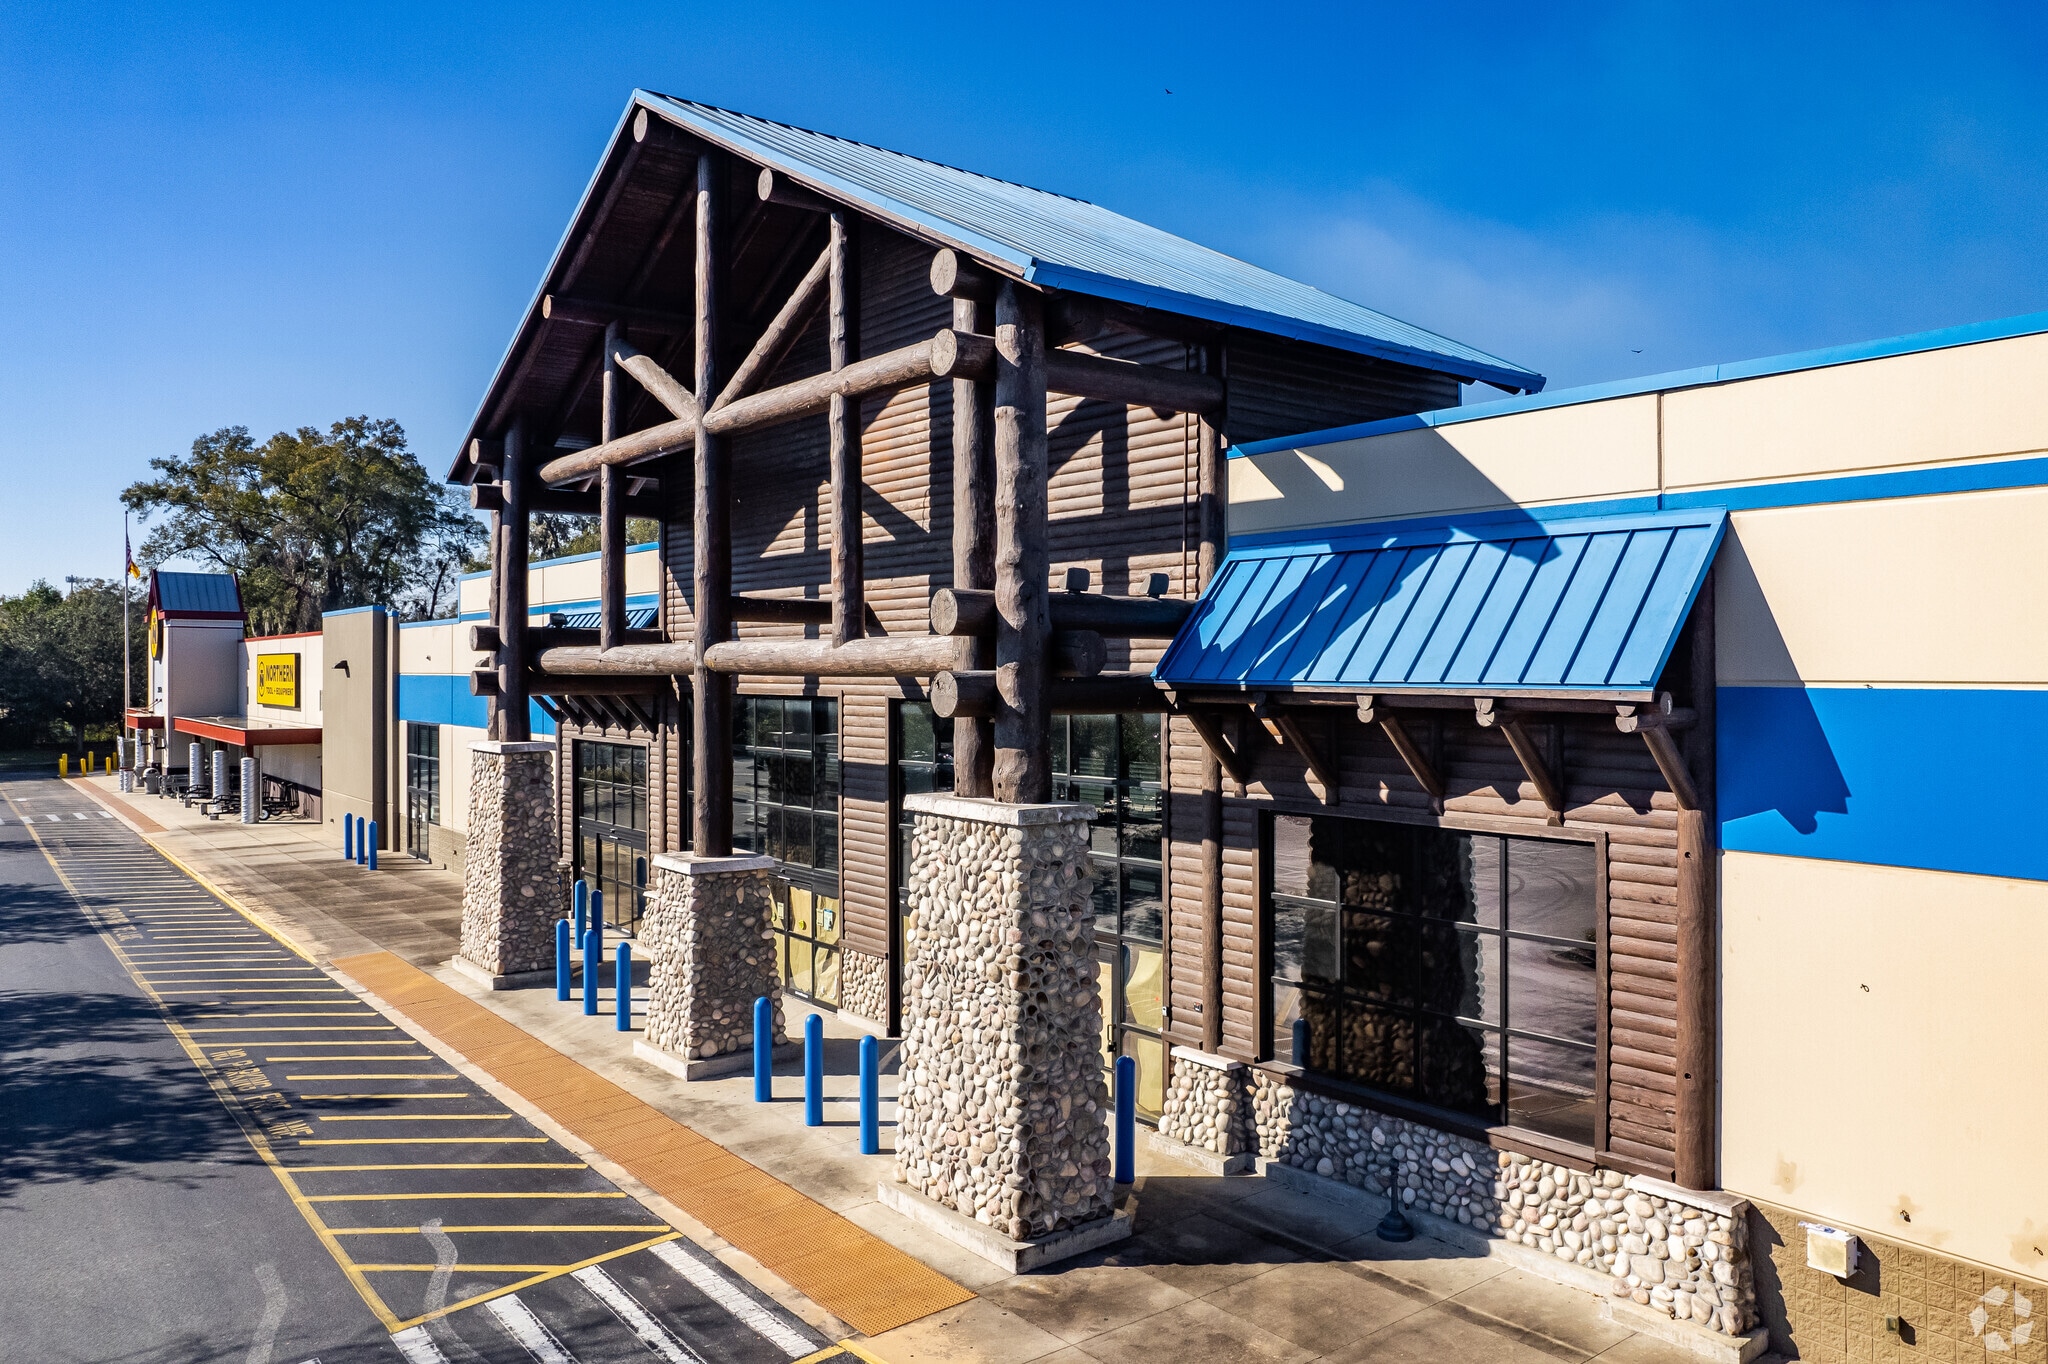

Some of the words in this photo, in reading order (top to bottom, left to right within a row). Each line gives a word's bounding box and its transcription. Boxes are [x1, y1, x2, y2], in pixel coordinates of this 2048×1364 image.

[265, 664, 294, 683] NORTHERN
[266, 686, 274, 695] TOOL
[276, 687, 294, 697] EQUIPMENT
[209, 1048, 247, 1061] NO
